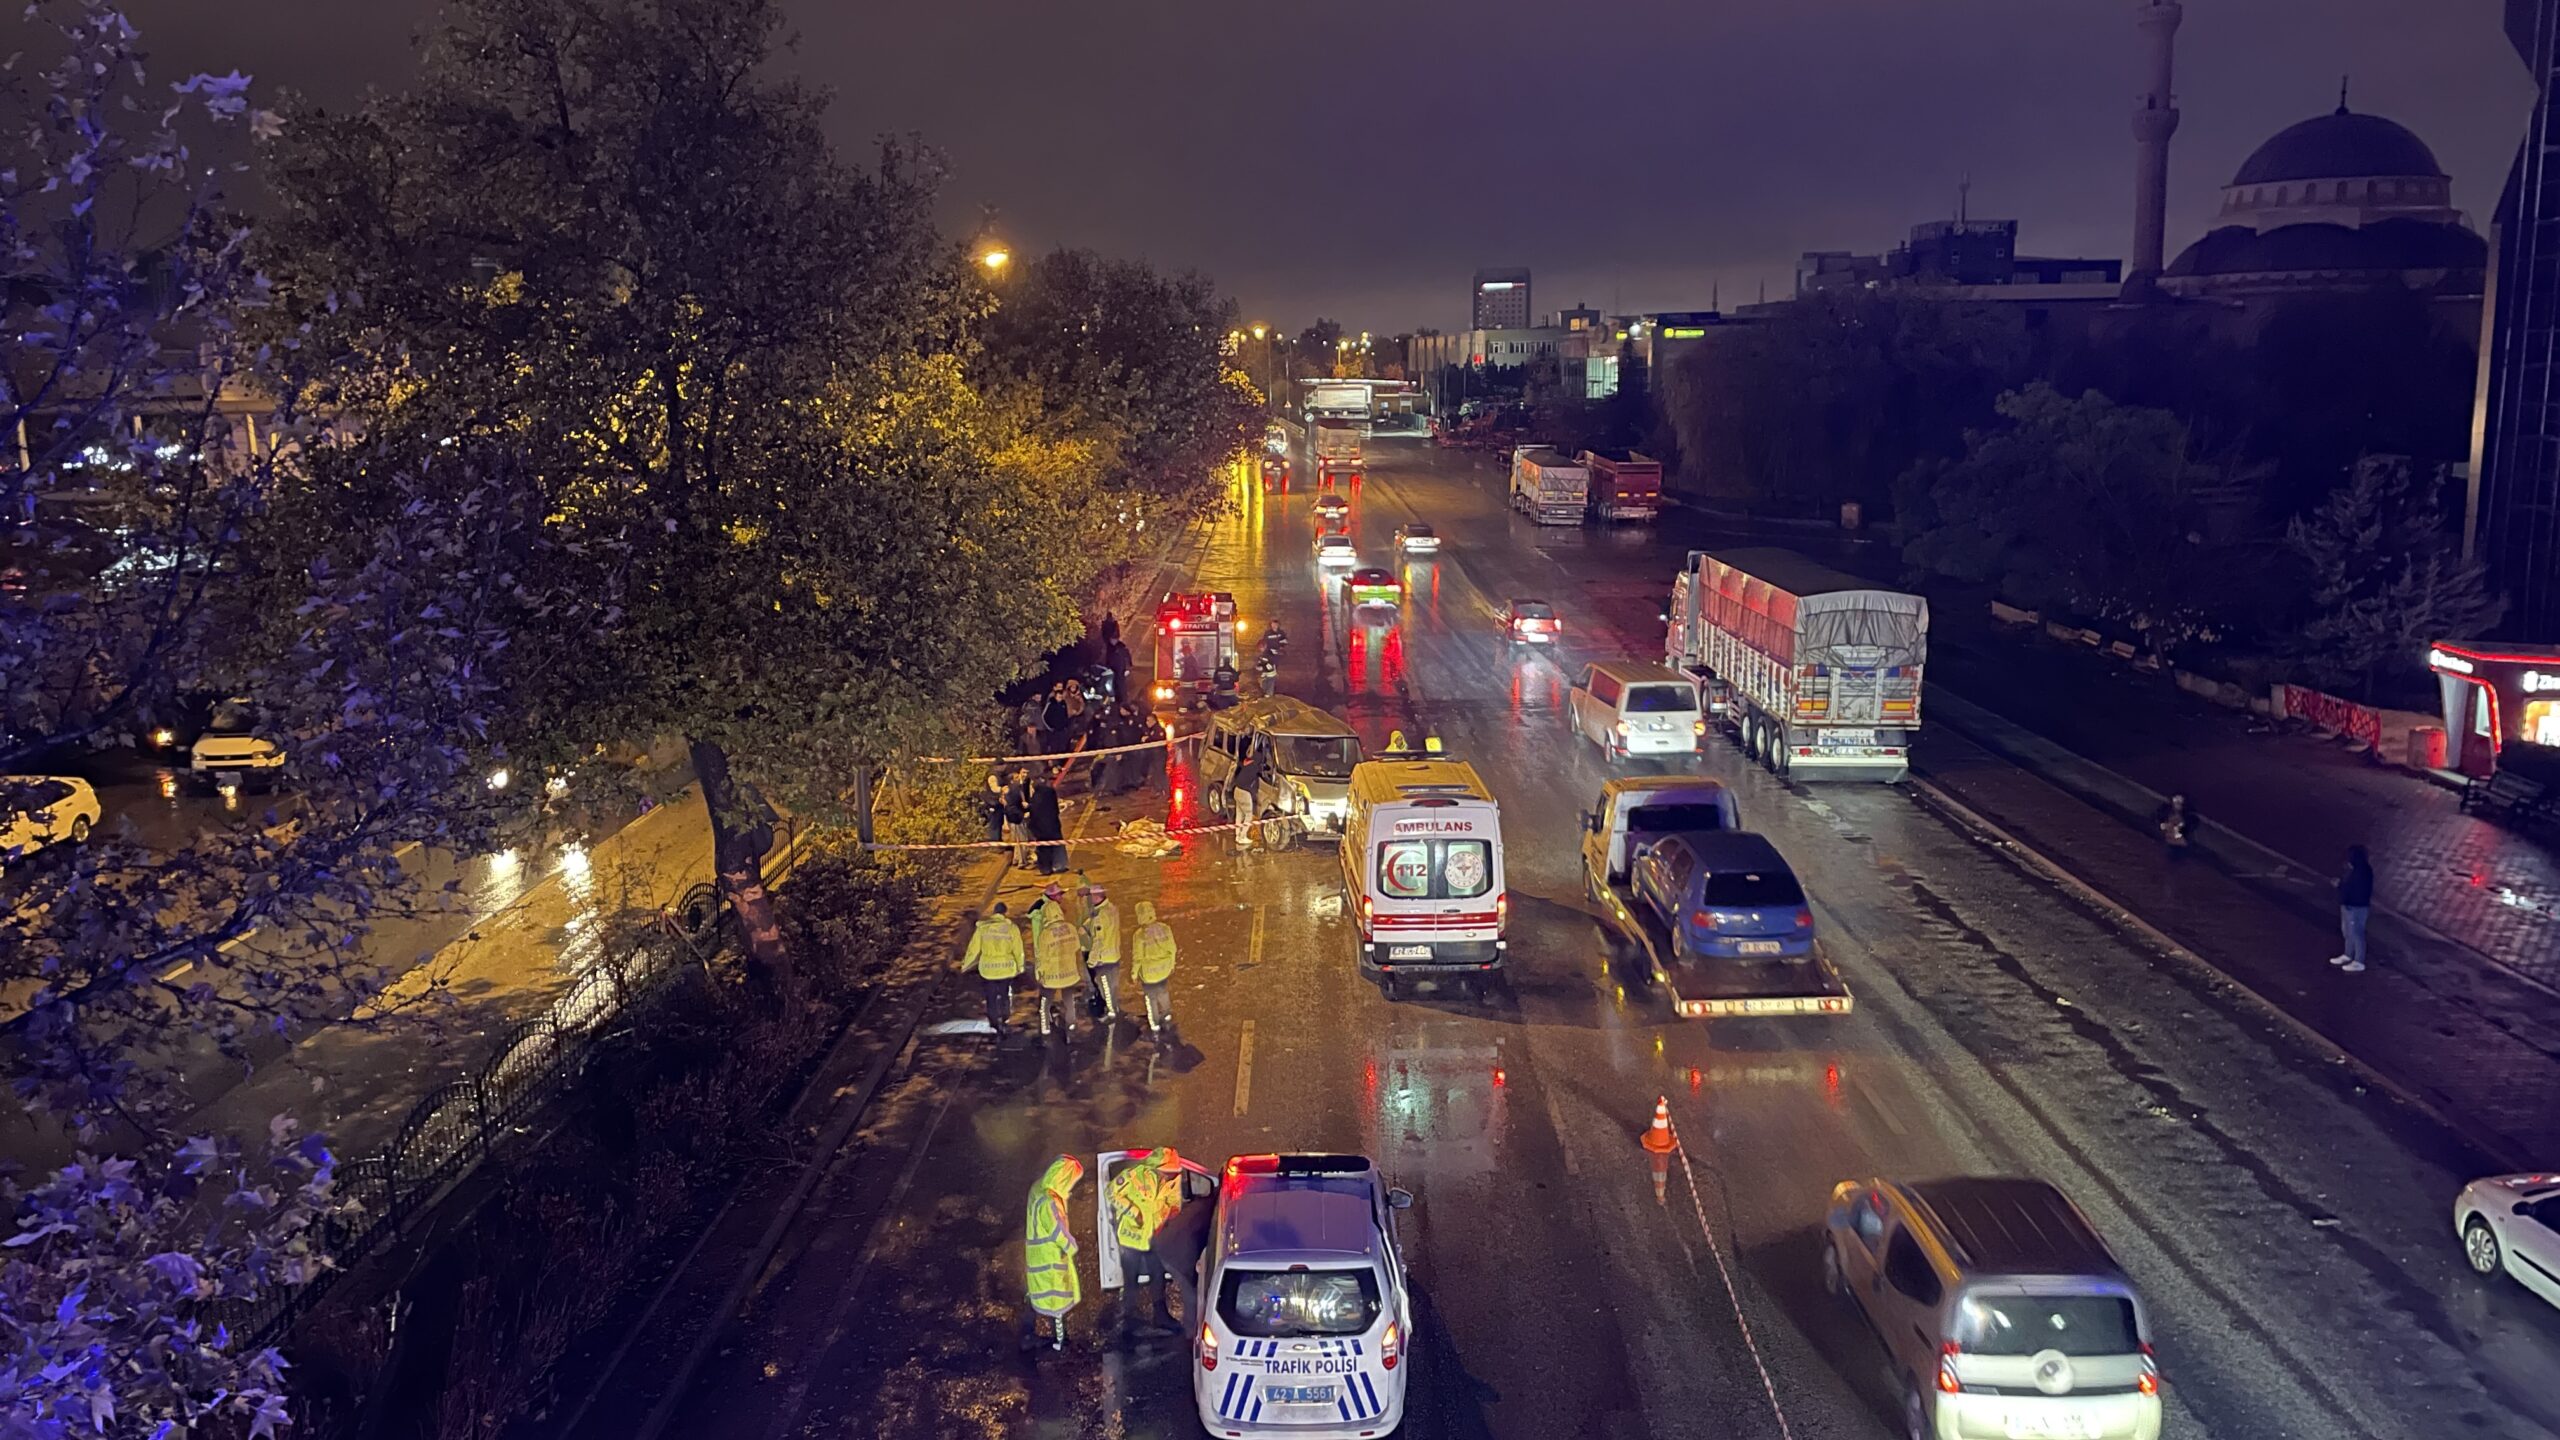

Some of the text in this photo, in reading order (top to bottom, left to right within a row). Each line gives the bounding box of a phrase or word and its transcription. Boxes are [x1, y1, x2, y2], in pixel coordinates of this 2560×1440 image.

[1395, 821, 1473, 833] AMBULANS
[1396, 864, 1427, 877] 112
[1265, 1357, 1311, 1374] TRAFİK
[1315, 1356, 1357, 1374] POLİSİ
[1273, 1388, 1288, 1400] 42
[1293, 1388, 1300, 1400] A
